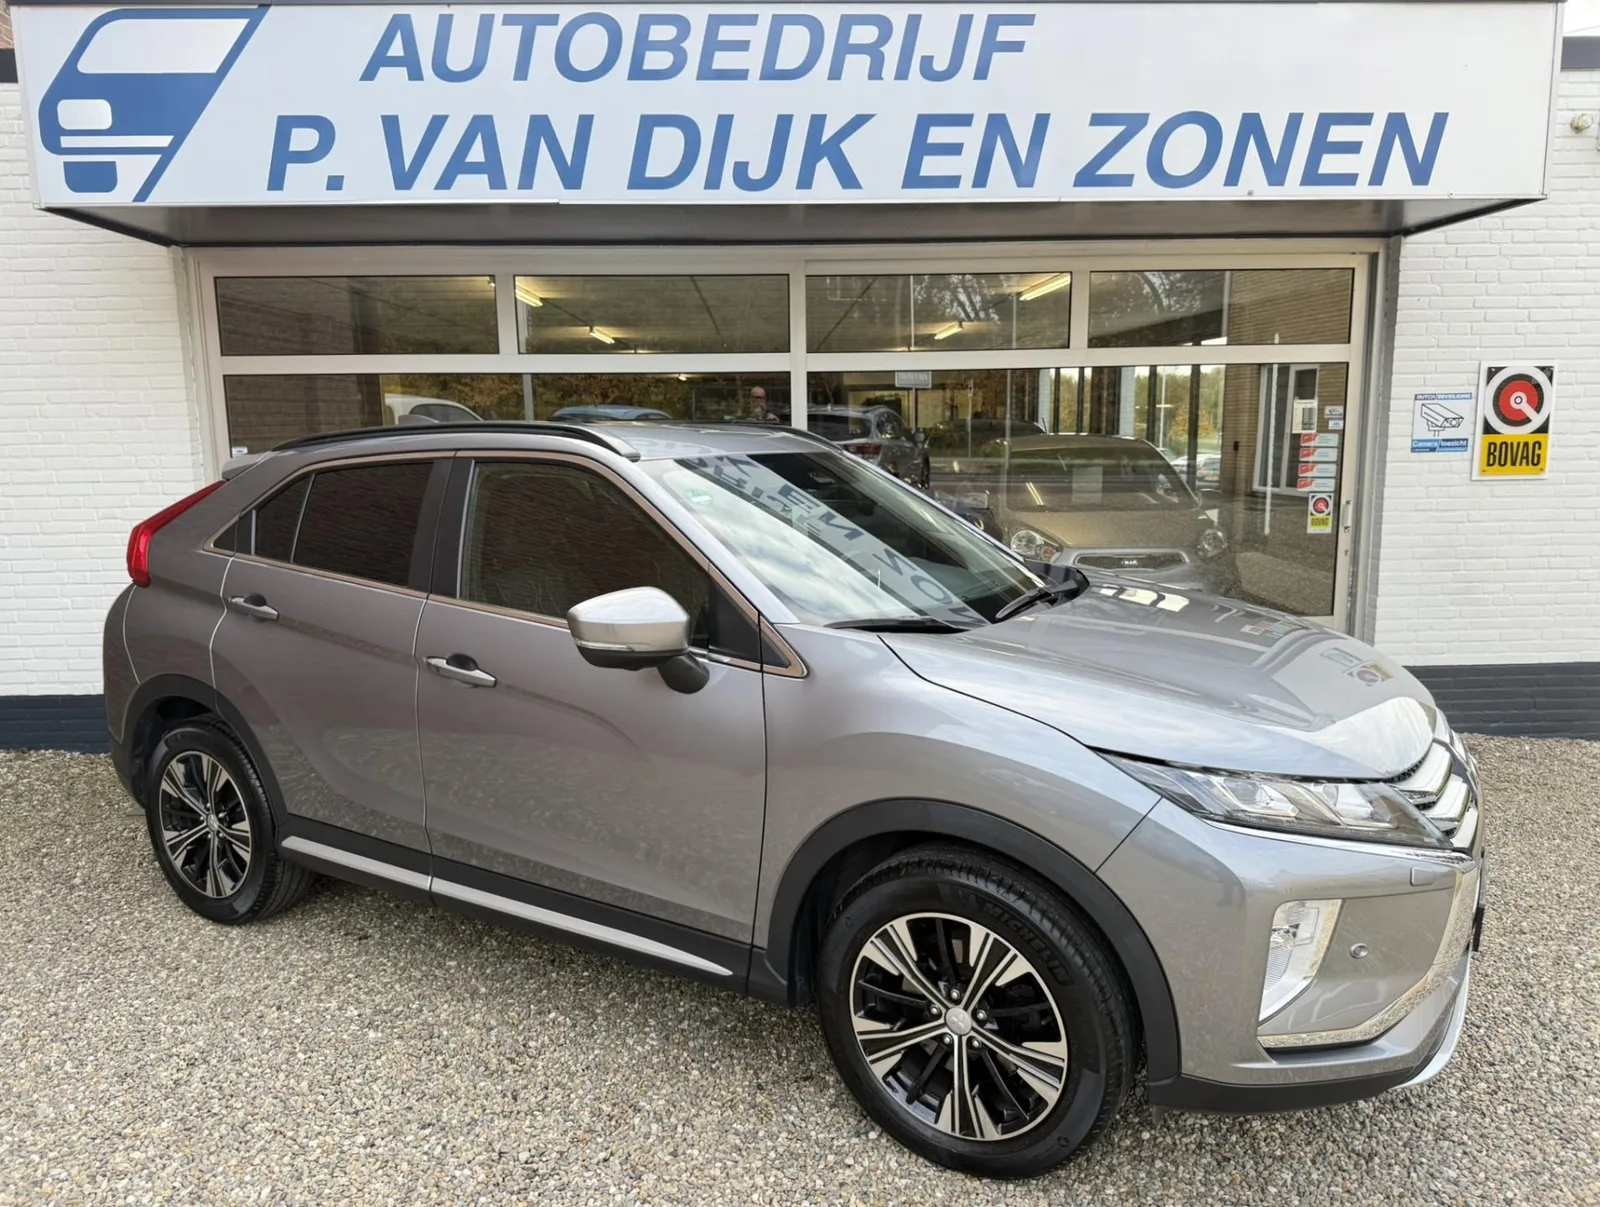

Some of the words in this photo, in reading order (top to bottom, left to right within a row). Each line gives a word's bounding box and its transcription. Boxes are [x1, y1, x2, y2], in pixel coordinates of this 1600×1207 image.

[360, 13, 1035, 83] AUTOBEDRIJF
[268, 114, 345, 193] P.
[381, 113, 595, 192] VAN
[628, 113, 874, 193] DIJK
[902, 113, 1050, 190] EN
[1074, 111, 1447, 189] ZONEN
[1412, 440, 1438, 448] Camera
[1440, 439, 1467, 447] toezicht
[1486, 441, 1542, 467] BOVAG
[1311, 517, 1329, 526] BOVAG
[980, 902, 1076, 986] MICHELIN
